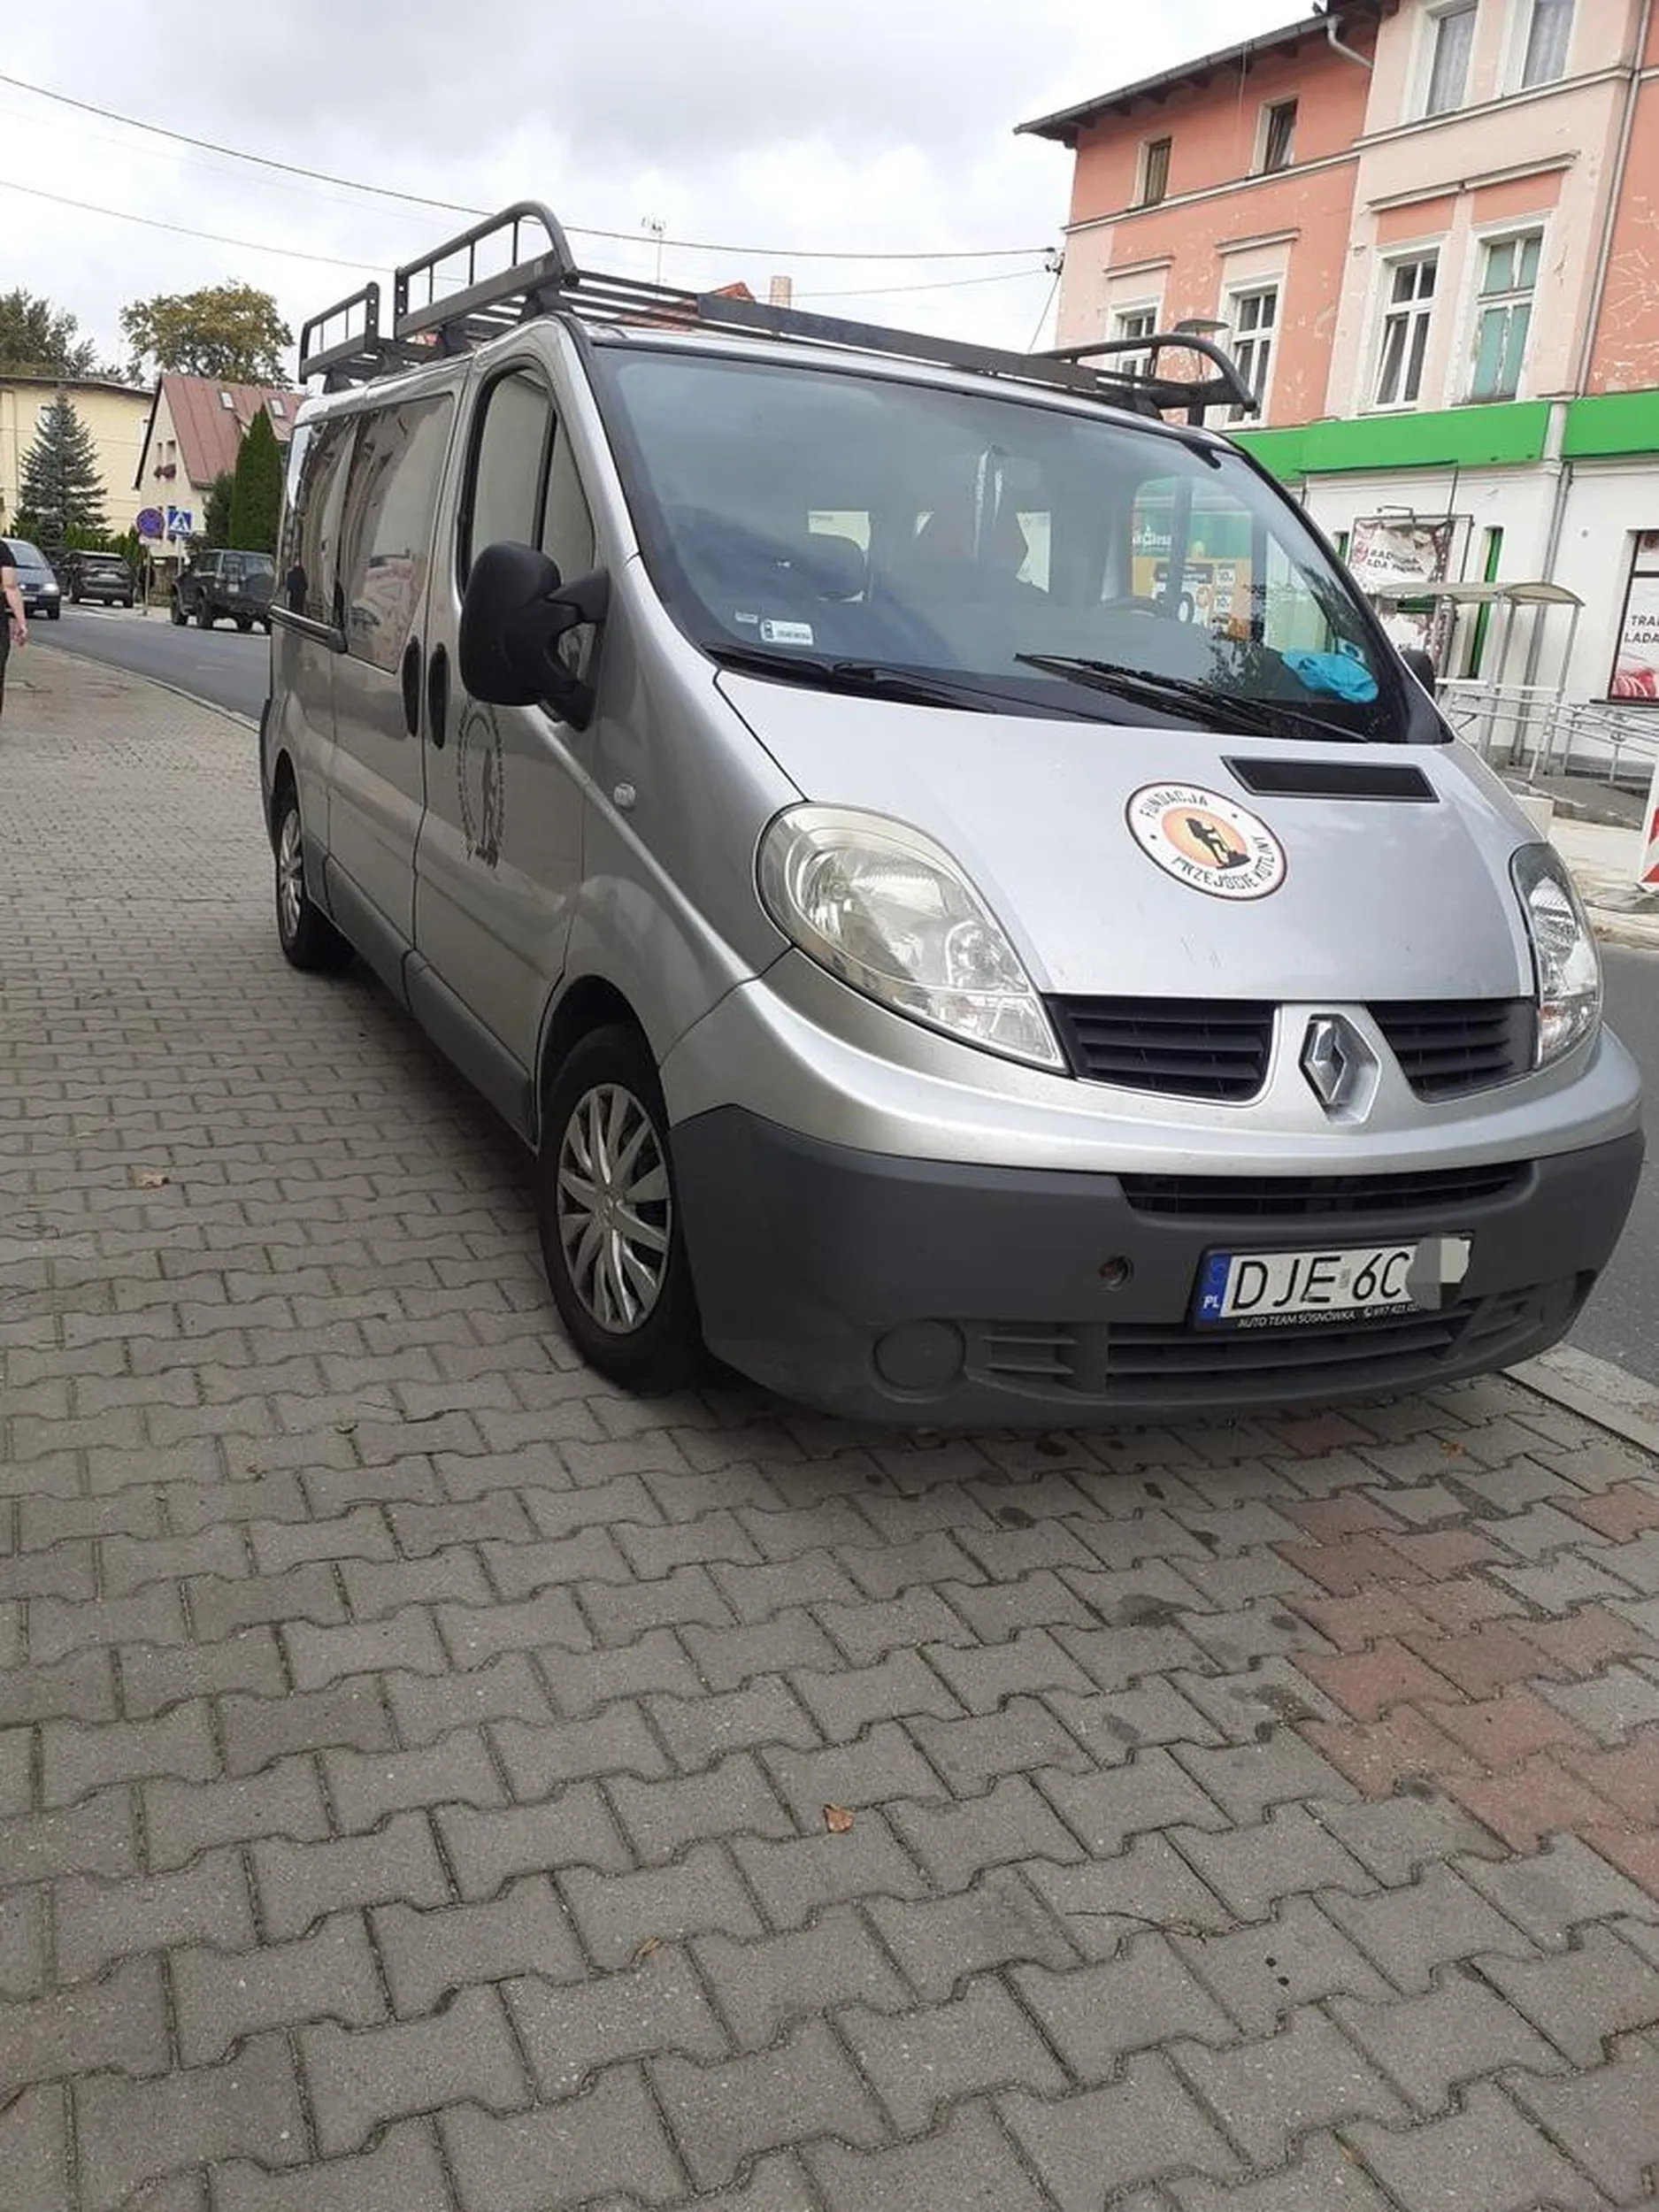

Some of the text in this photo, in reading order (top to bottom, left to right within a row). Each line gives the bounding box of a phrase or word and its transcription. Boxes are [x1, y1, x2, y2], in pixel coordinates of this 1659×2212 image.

[1140, 789, 1209, 819] FUNDACJA
[1231, 1256, 1341, 1310] DJE
[1203, 1294, 1220, 1309] PL
[1239, 1316, 1268, 1328] AUTO
[1269, 1313, 1297, 1325] TEAM
